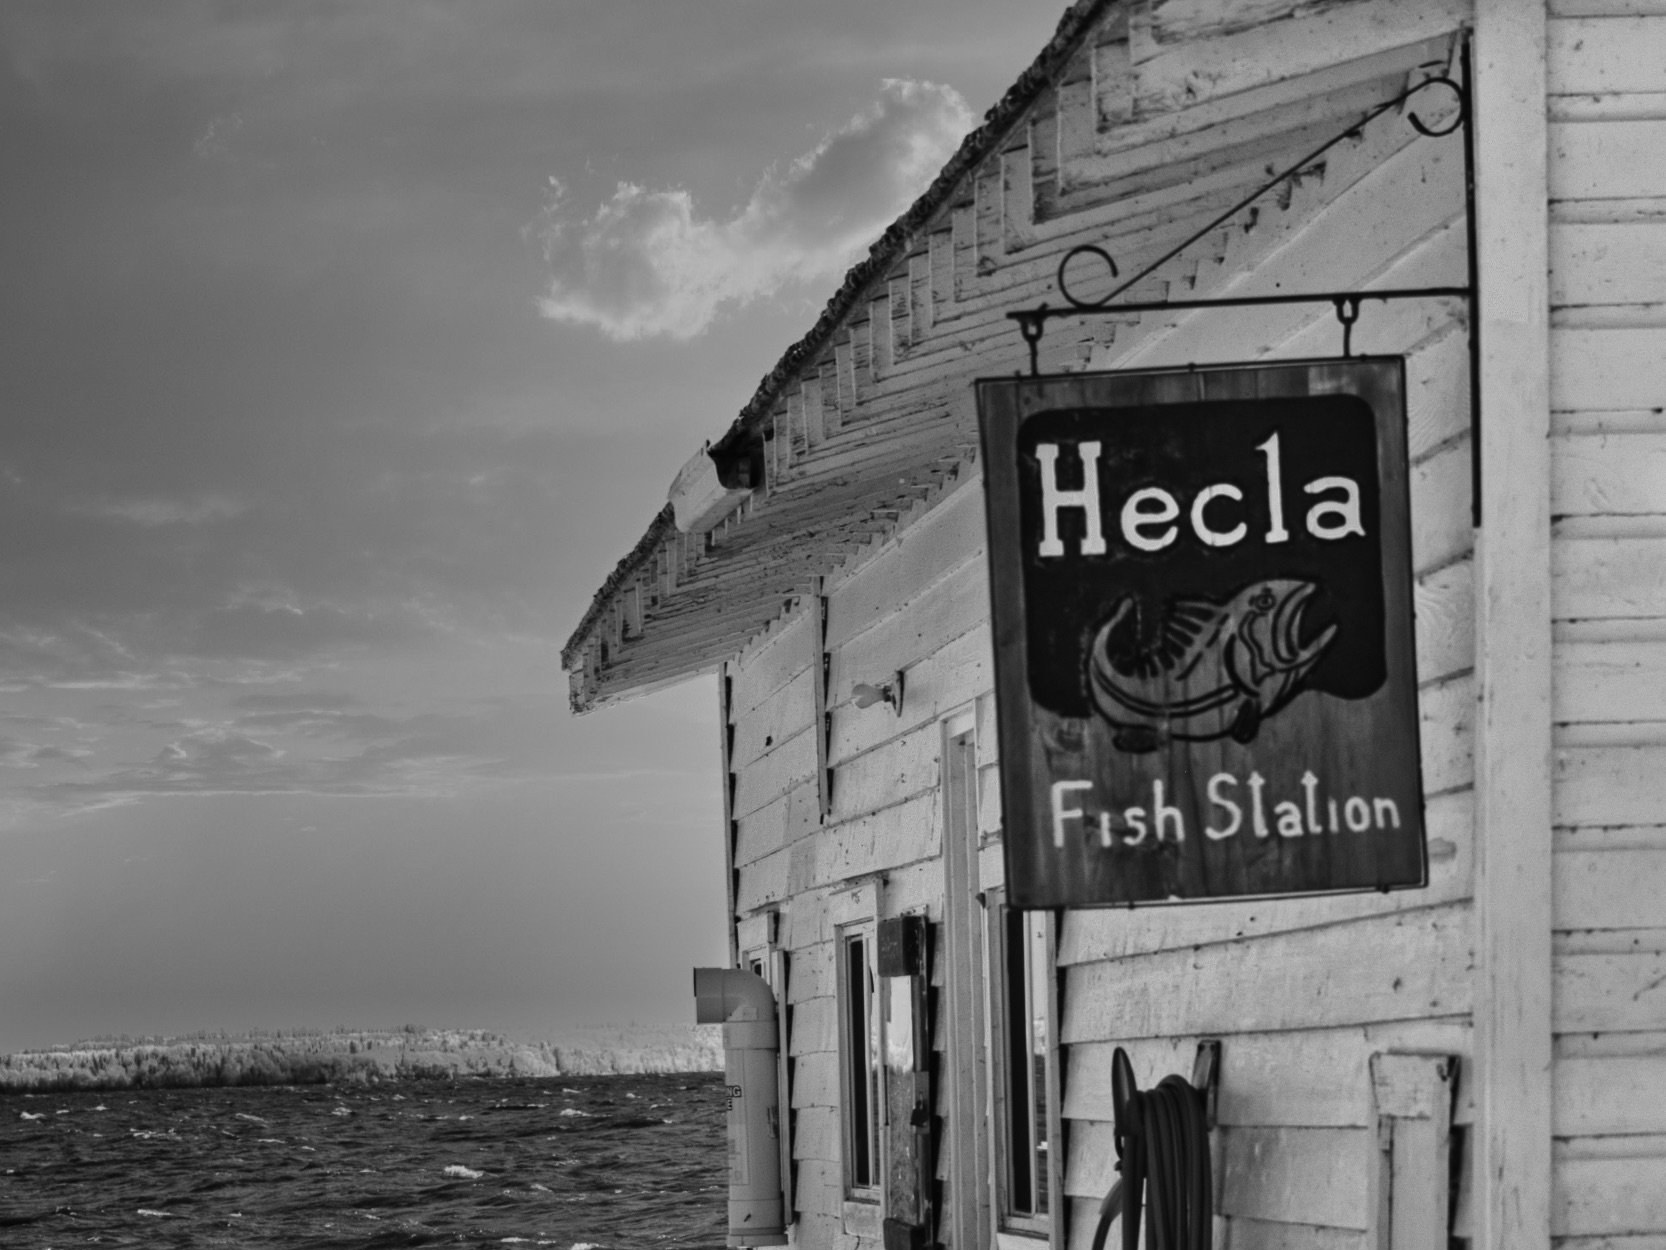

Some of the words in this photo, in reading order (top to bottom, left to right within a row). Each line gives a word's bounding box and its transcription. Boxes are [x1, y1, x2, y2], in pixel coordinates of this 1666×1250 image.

[1034, 431, 1366, 558] Hecla
[1051, 778, 1185, 848] Fish
[1205, 770, 1401, 842] Station
